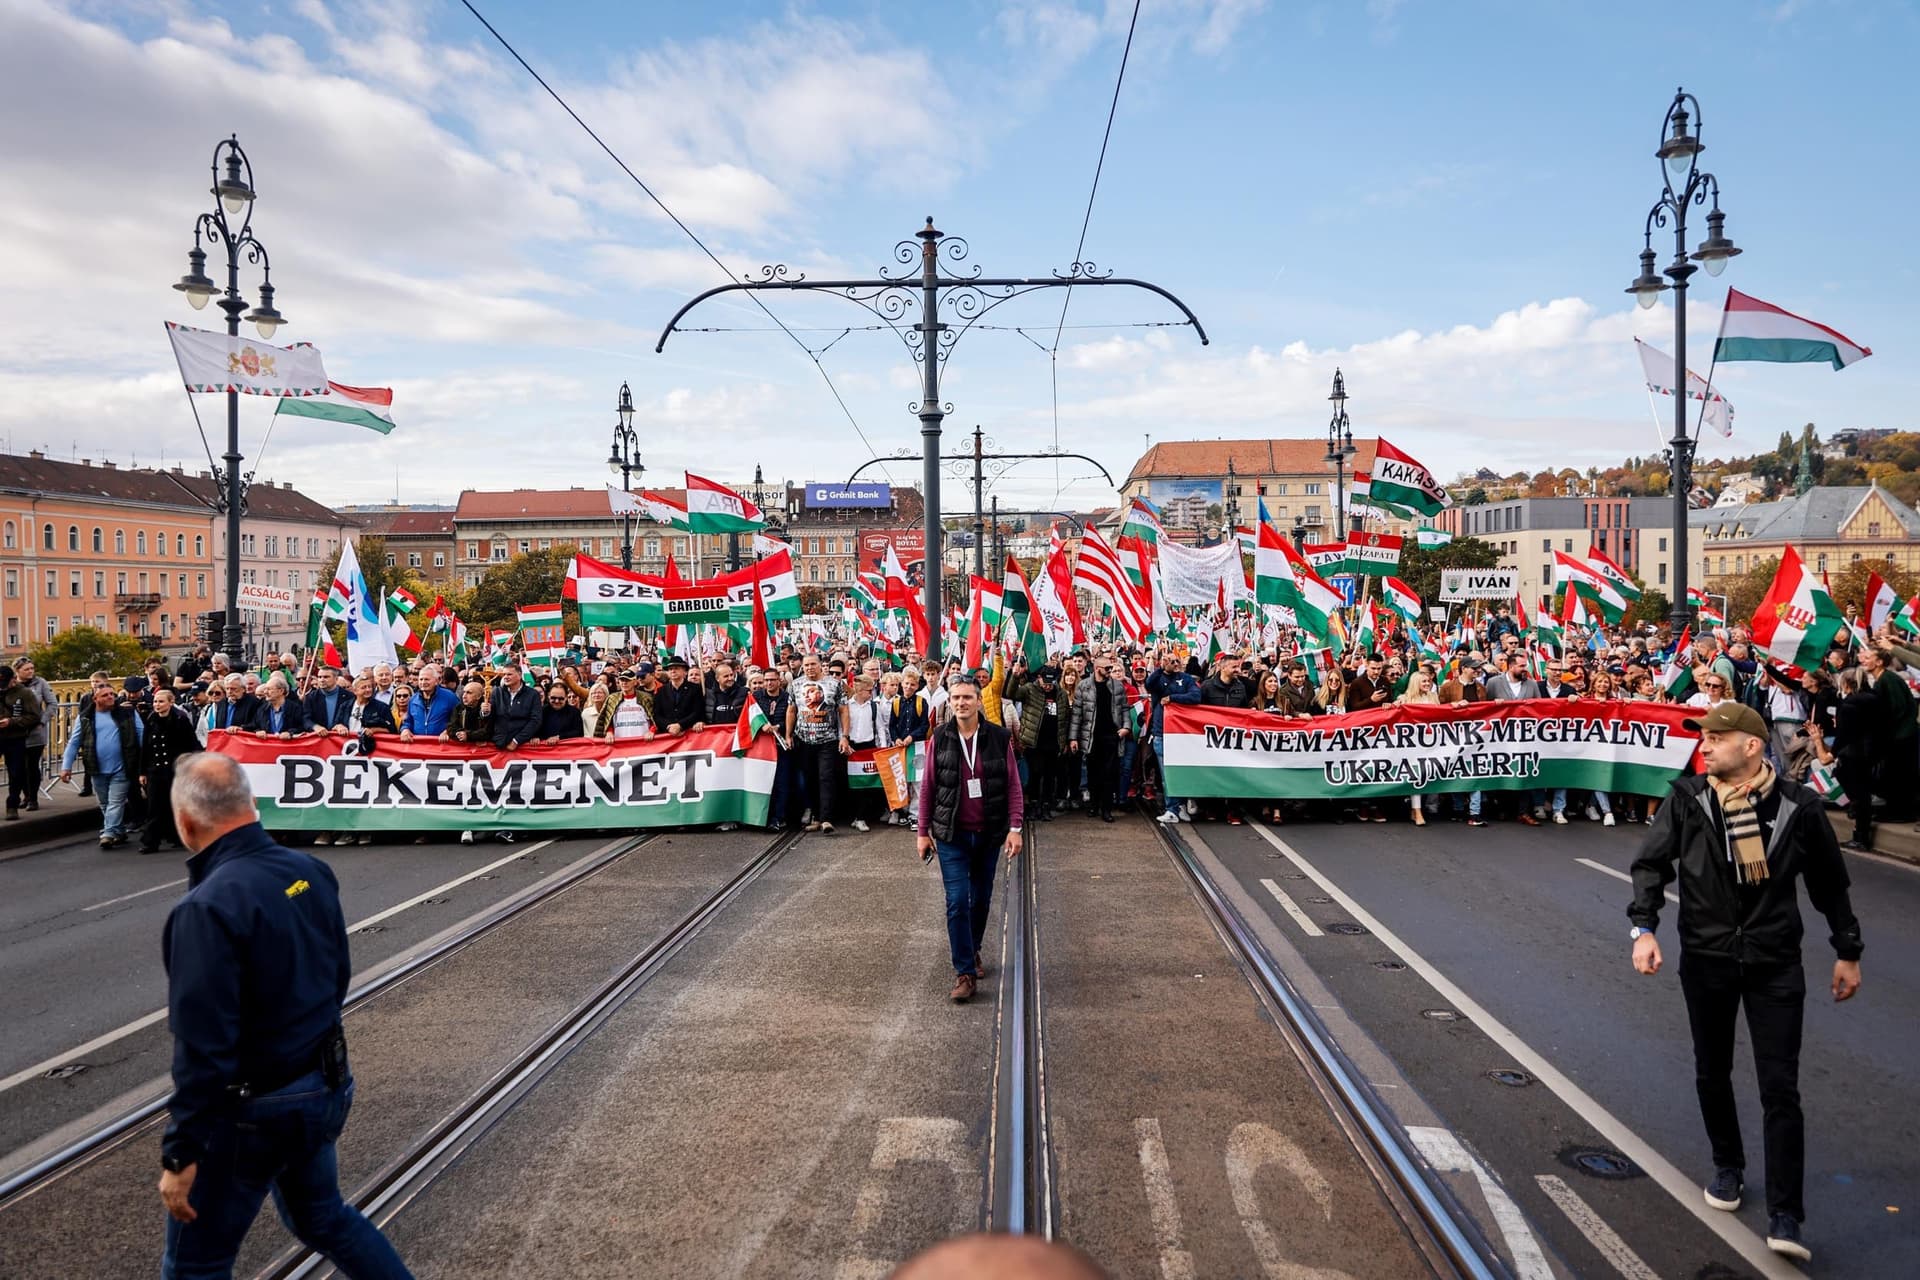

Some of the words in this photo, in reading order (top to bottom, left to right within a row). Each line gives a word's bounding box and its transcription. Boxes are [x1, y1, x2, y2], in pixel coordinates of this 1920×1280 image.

[1381, 461, 1446, 500] KAKASD
[857, 491, 879, 499] Bank
[1468, 573, 1510, 588] IVÁN
[242, 586, 290, 601] ACSALAG
[668, 598, 724, 612] GARBOLC
[1206, 726, 1245, 750] MI
[1252, 728, 1322, 752] NEM
[1328, 719, 1484, 751] AKARUNK
[1491, 720, 1667, 749] MEGHALNI
[279, 743, 712, 804] BÉKEMENET
[1325, 745, 1539, 787] UKRAJNÁÉRT!
